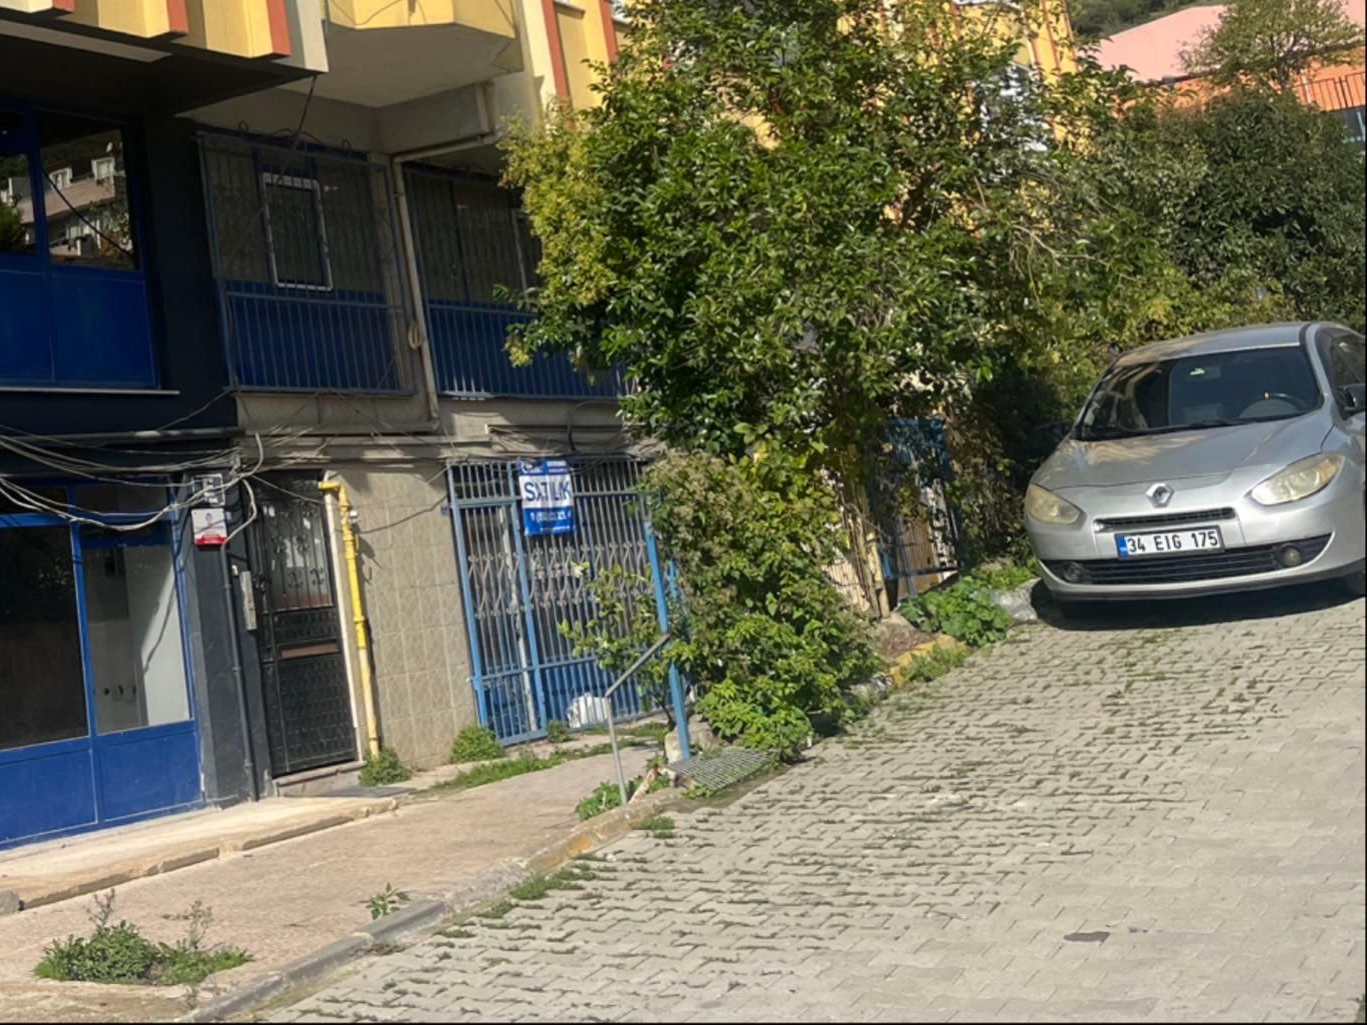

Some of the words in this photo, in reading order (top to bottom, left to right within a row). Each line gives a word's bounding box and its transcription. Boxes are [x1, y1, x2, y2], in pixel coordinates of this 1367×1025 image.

[1127, 538, 1146, 553] 34
[1153, 534, 1182, 551] EIG
[1191, 531, 1218, 548] 175
